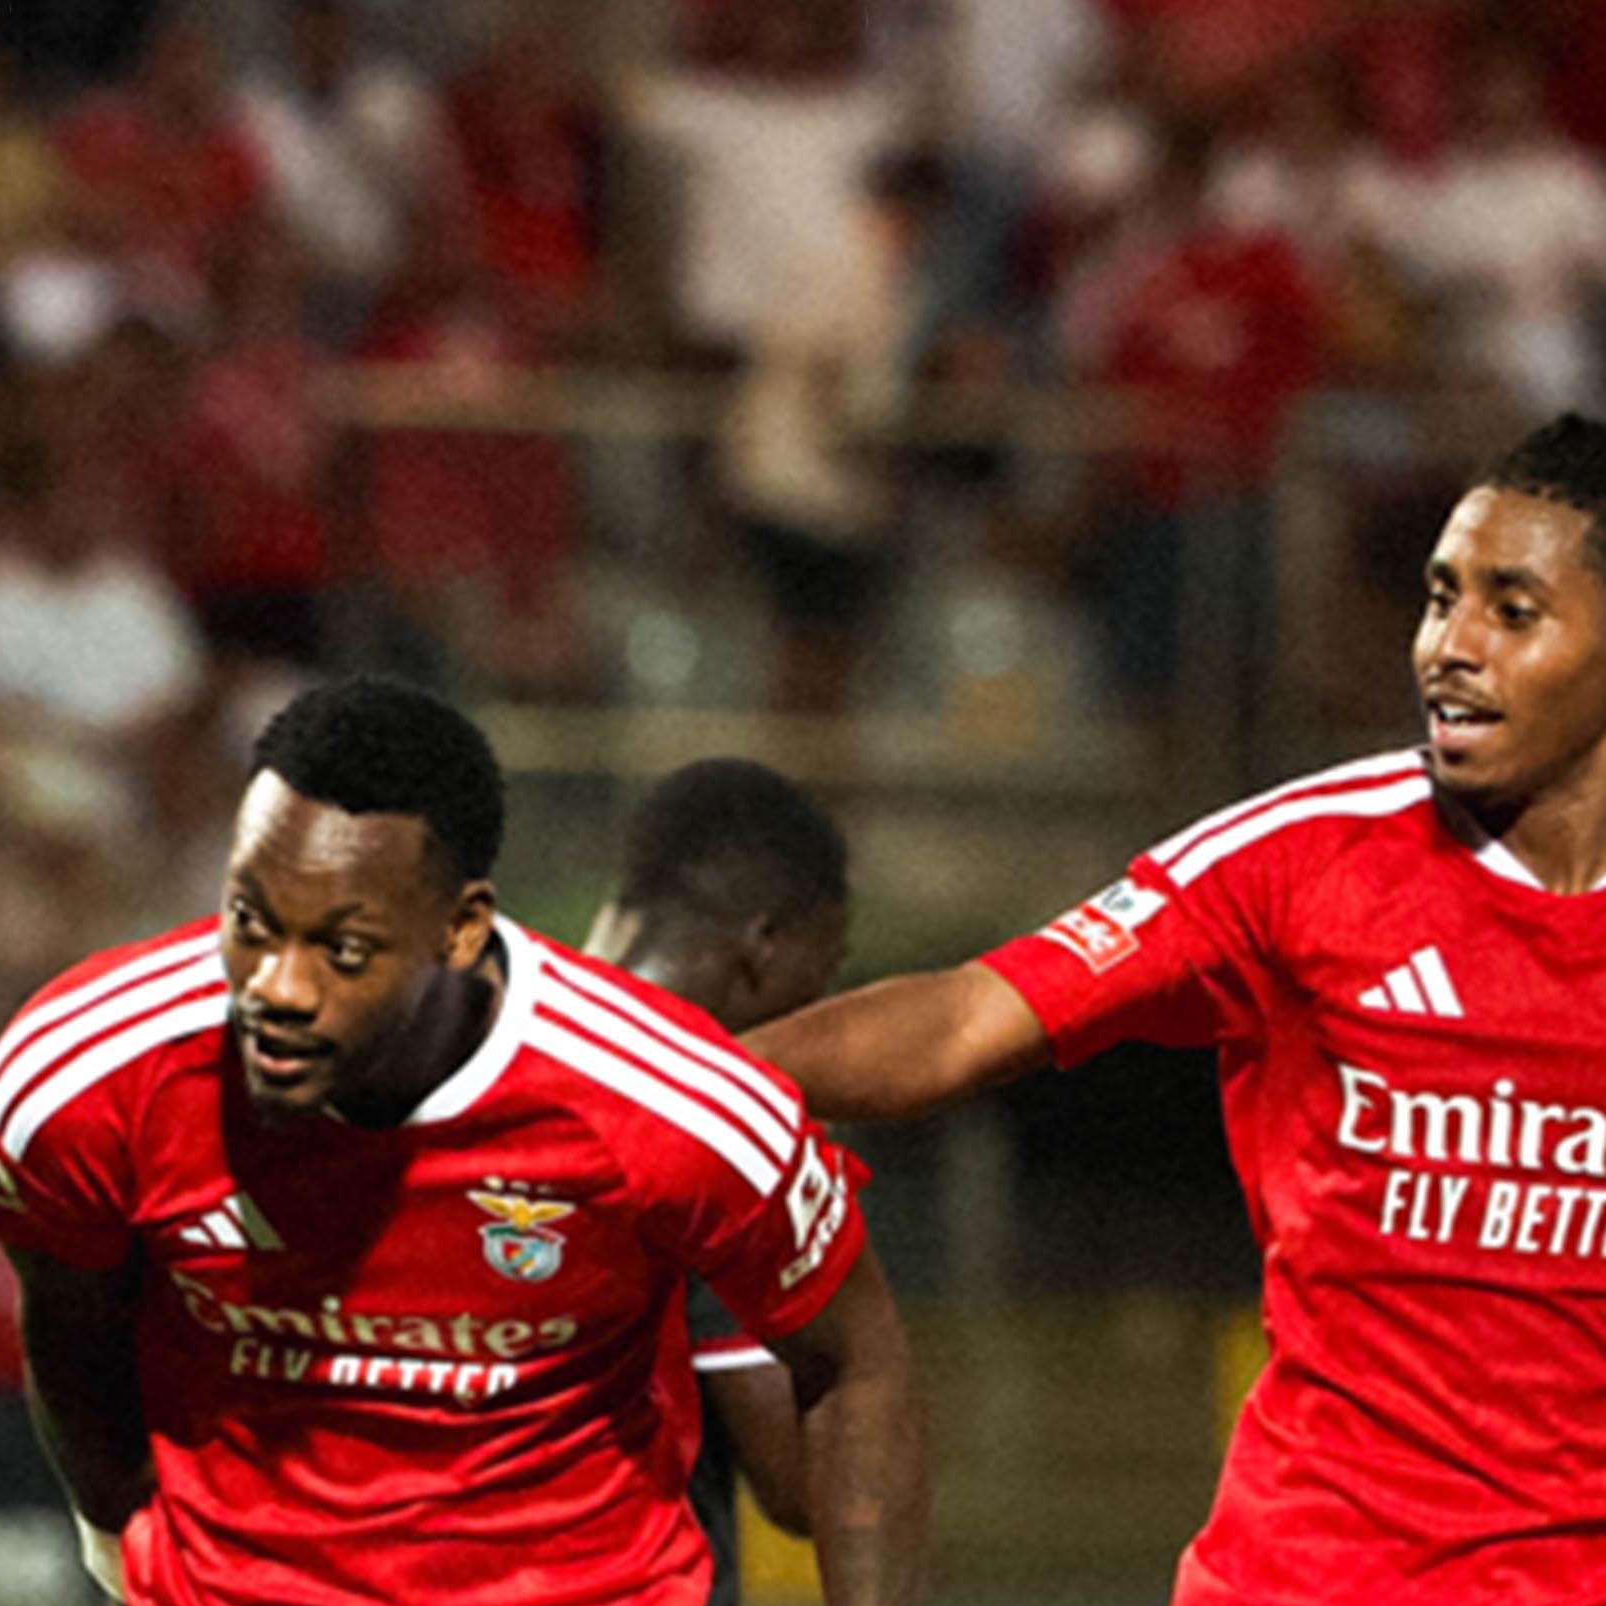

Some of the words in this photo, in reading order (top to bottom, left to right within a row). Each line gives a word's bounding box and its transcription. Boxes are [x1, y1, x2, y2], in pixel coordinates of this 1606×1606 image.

[1337, 1060, 1605, 1177] Emira
[1379, 1167, 1471, 1244] FLY
[1477, 1180, 1605, 1258] BETT
[170, 1268, 578, 1358] Emirates
